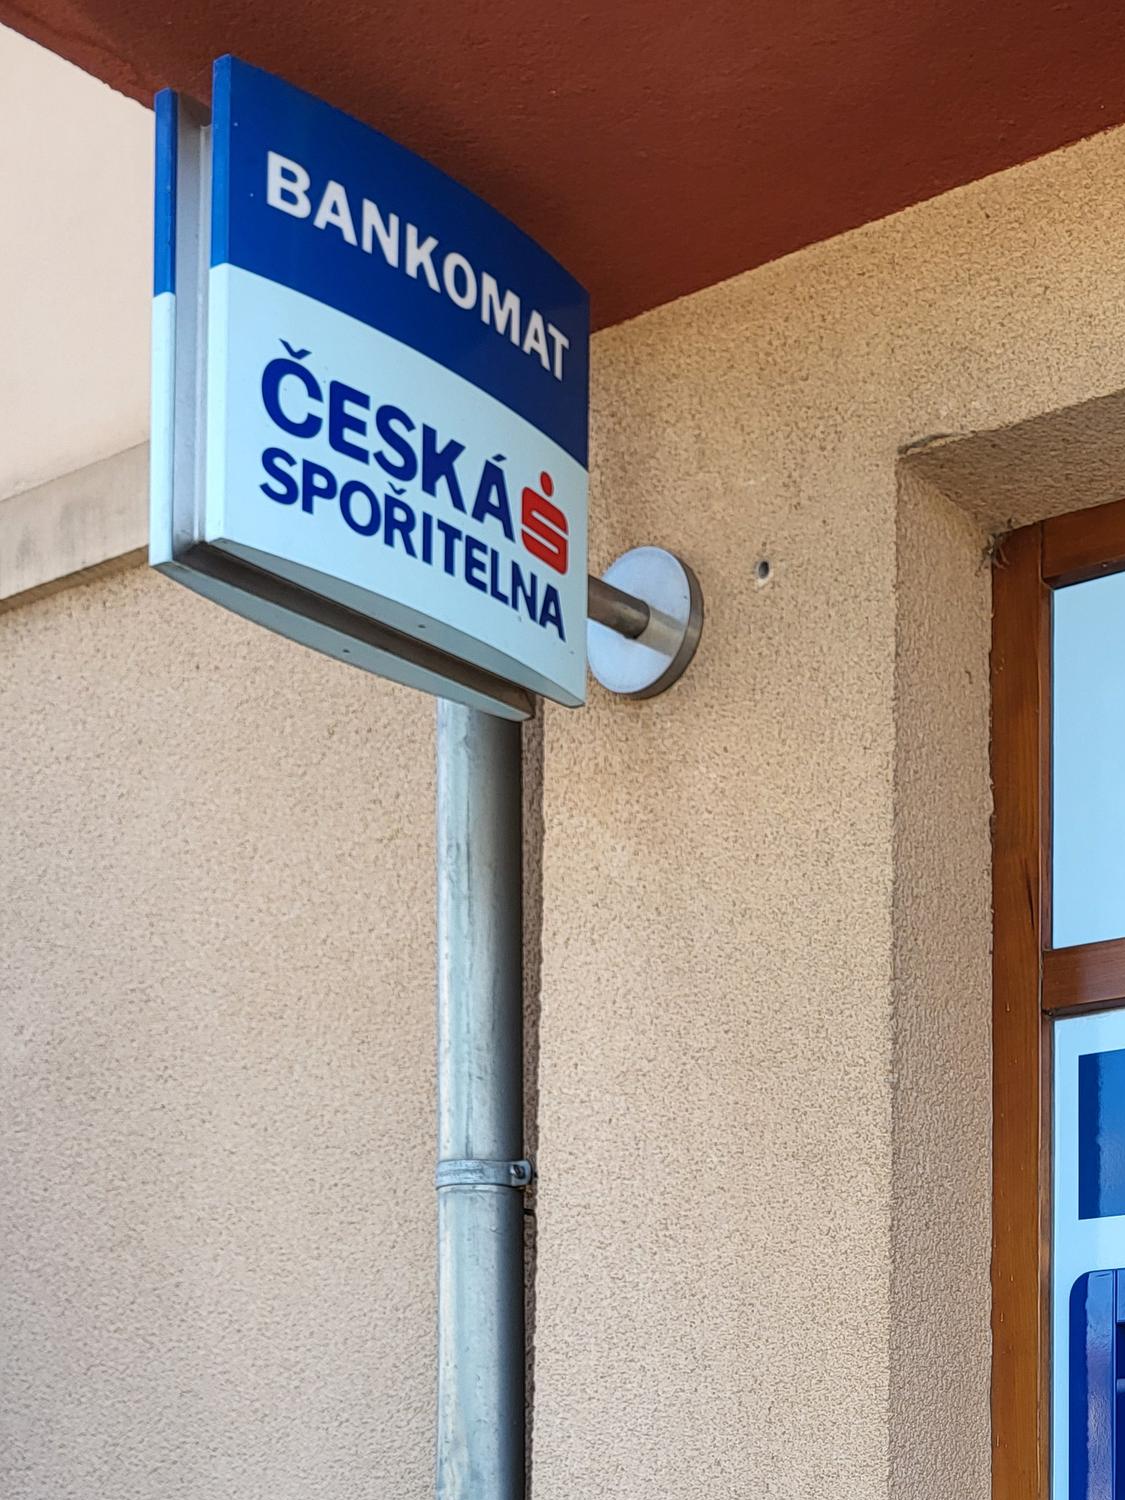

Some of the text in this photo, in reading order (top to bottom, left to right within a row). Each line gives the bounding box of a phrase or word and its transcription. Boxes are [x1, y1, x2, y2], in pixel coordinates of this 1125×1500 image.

[266, 151, 570, 382] BANKOMAT
[260, 338, 516, 543] ČESKÁ
[259, 446, 567, 641] SPOŘITELNA
